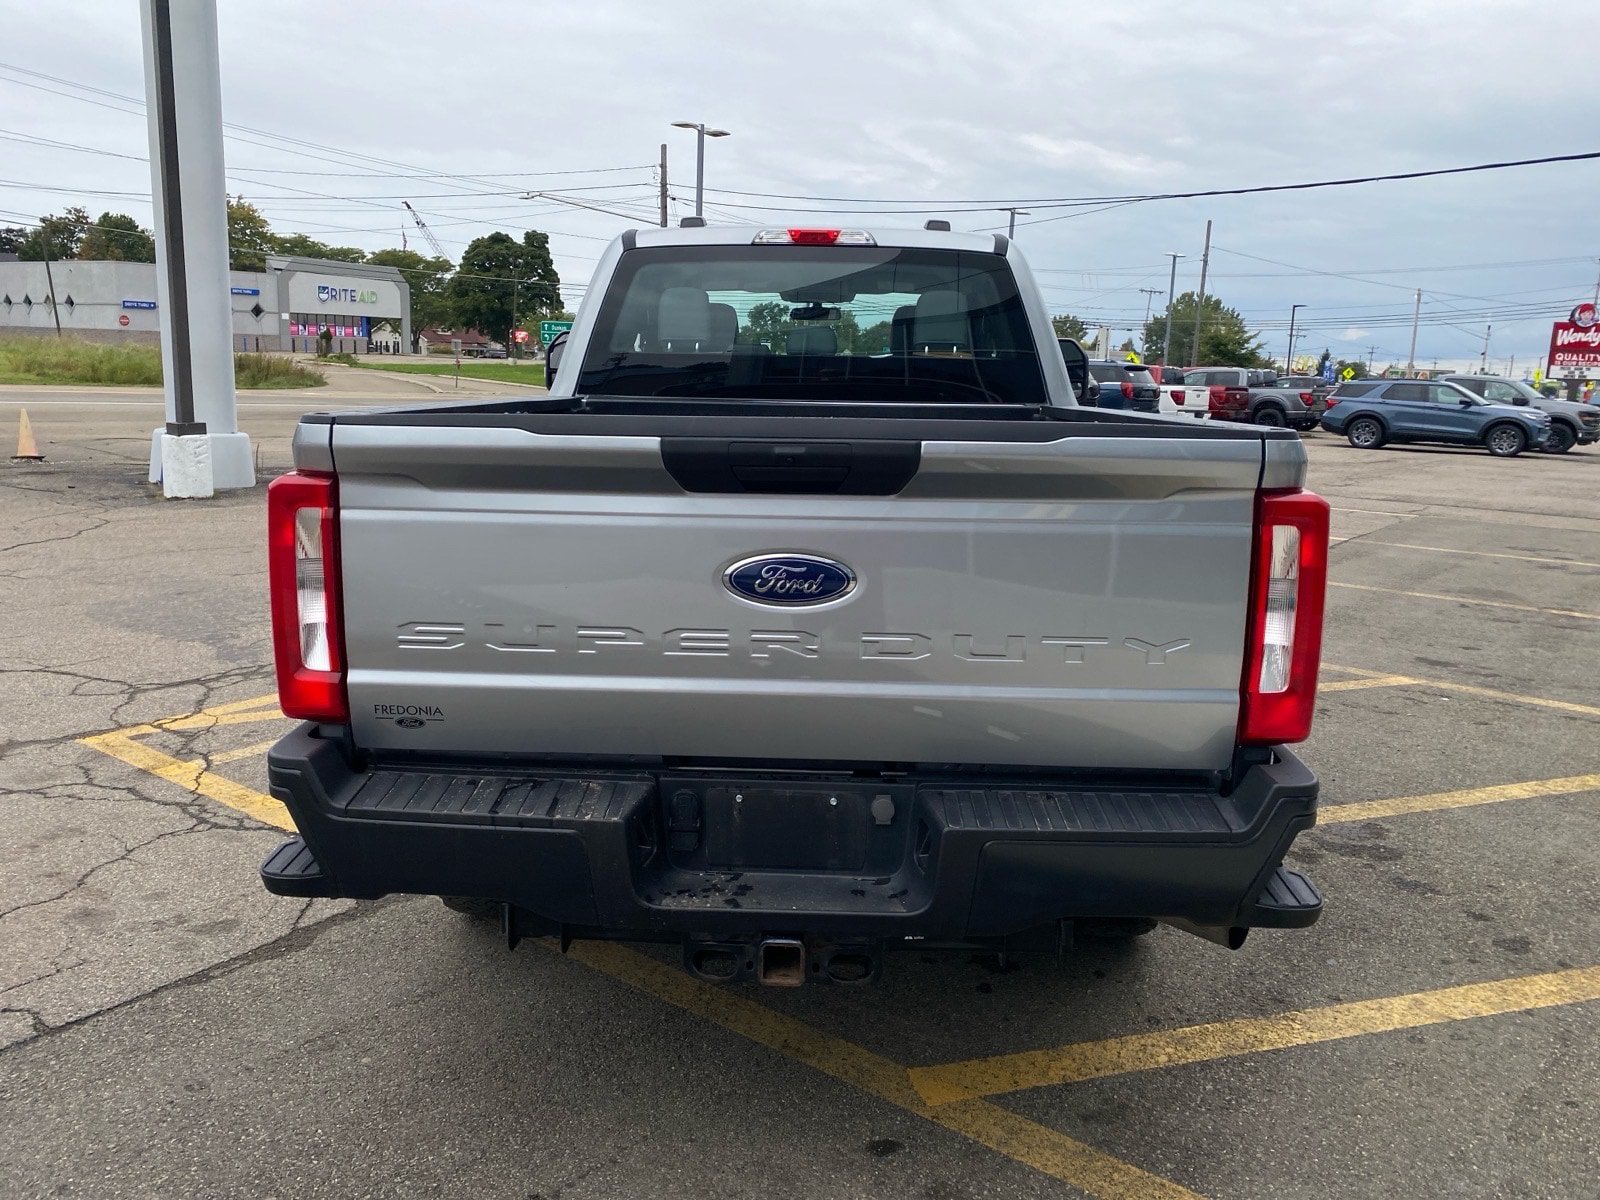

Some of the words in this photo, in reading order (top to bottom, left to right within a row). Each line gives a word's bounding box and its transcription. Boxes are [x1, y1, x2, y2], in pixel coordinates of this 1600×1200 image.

[330, 287, 357, 302] RITE
[357, 289, 378, 304] AID
[753, 563, 825, 595] Ford
[396, 621, 821, 658] SUPER
[860, 632, 1191, 665] DUTY
[373, 704, 444, 716] FREDONIA
